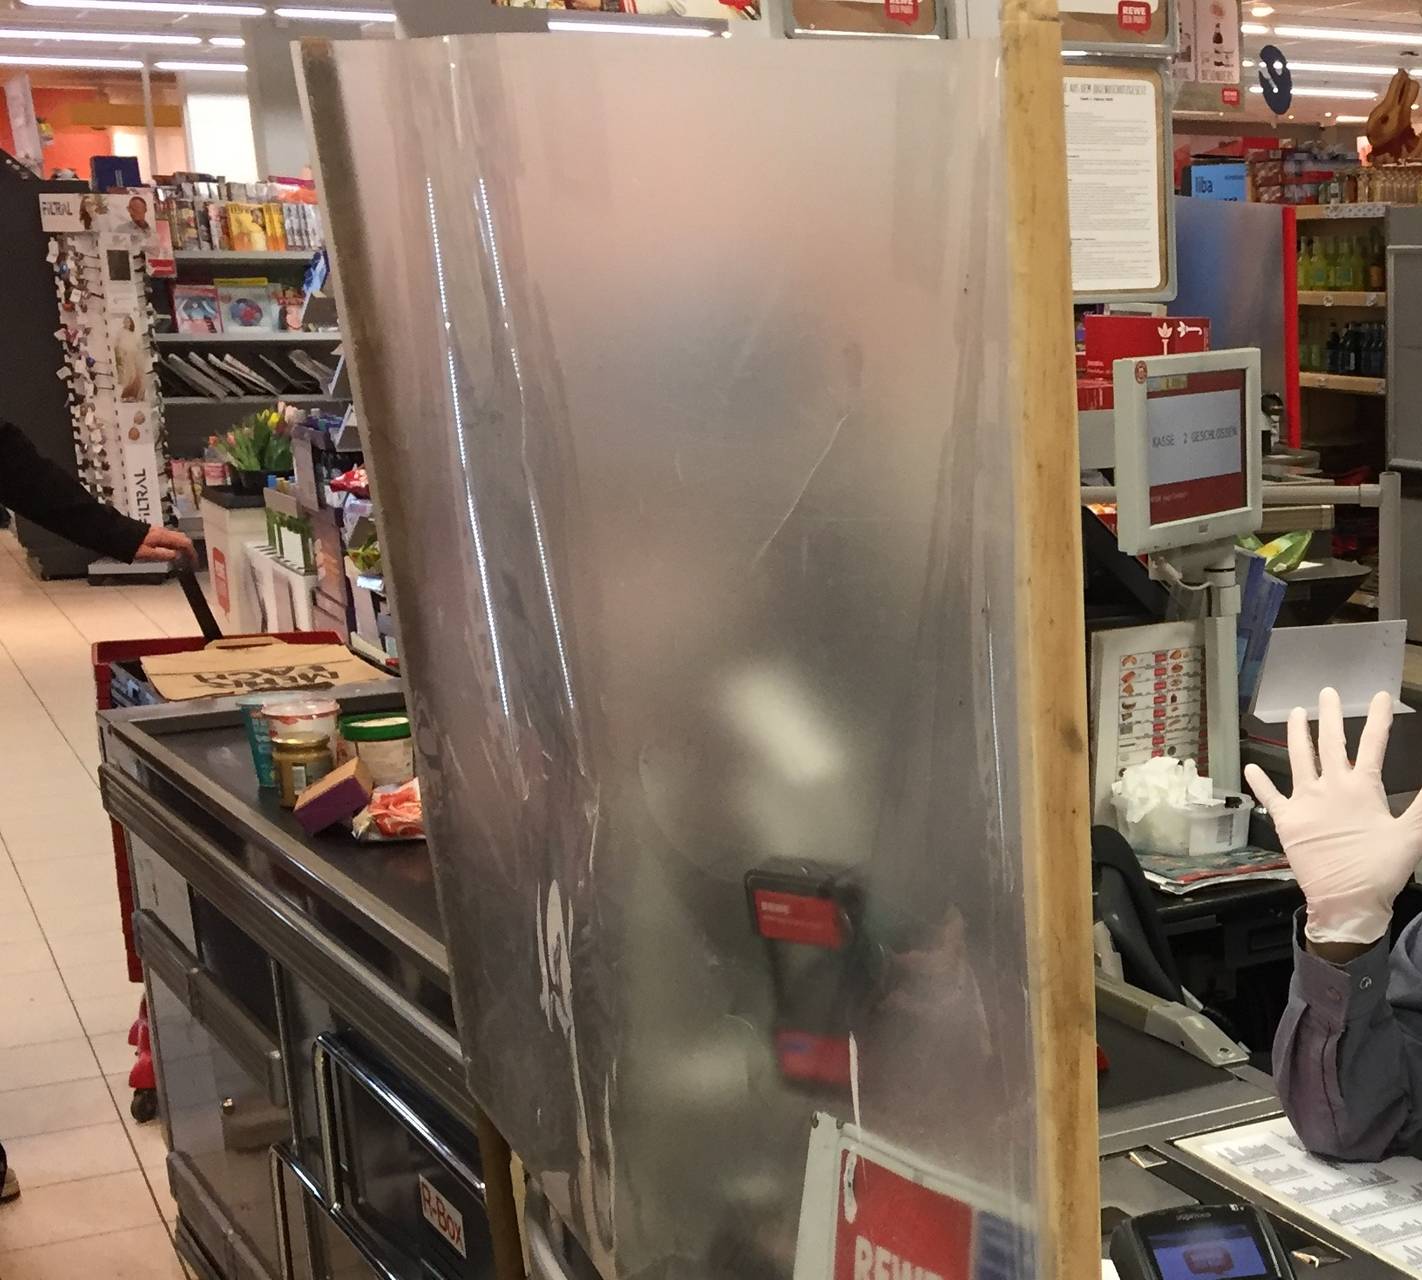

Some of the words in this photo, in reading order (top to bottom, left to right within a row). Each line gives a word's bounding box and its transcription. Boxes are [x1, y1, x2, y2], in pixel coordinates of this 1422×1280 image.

[1122, 6, 1146, 15] REWE
[1152, 433, 1175, 448] KASSE
[1191, 426, 1237, 443] GESCHLOSSEN
